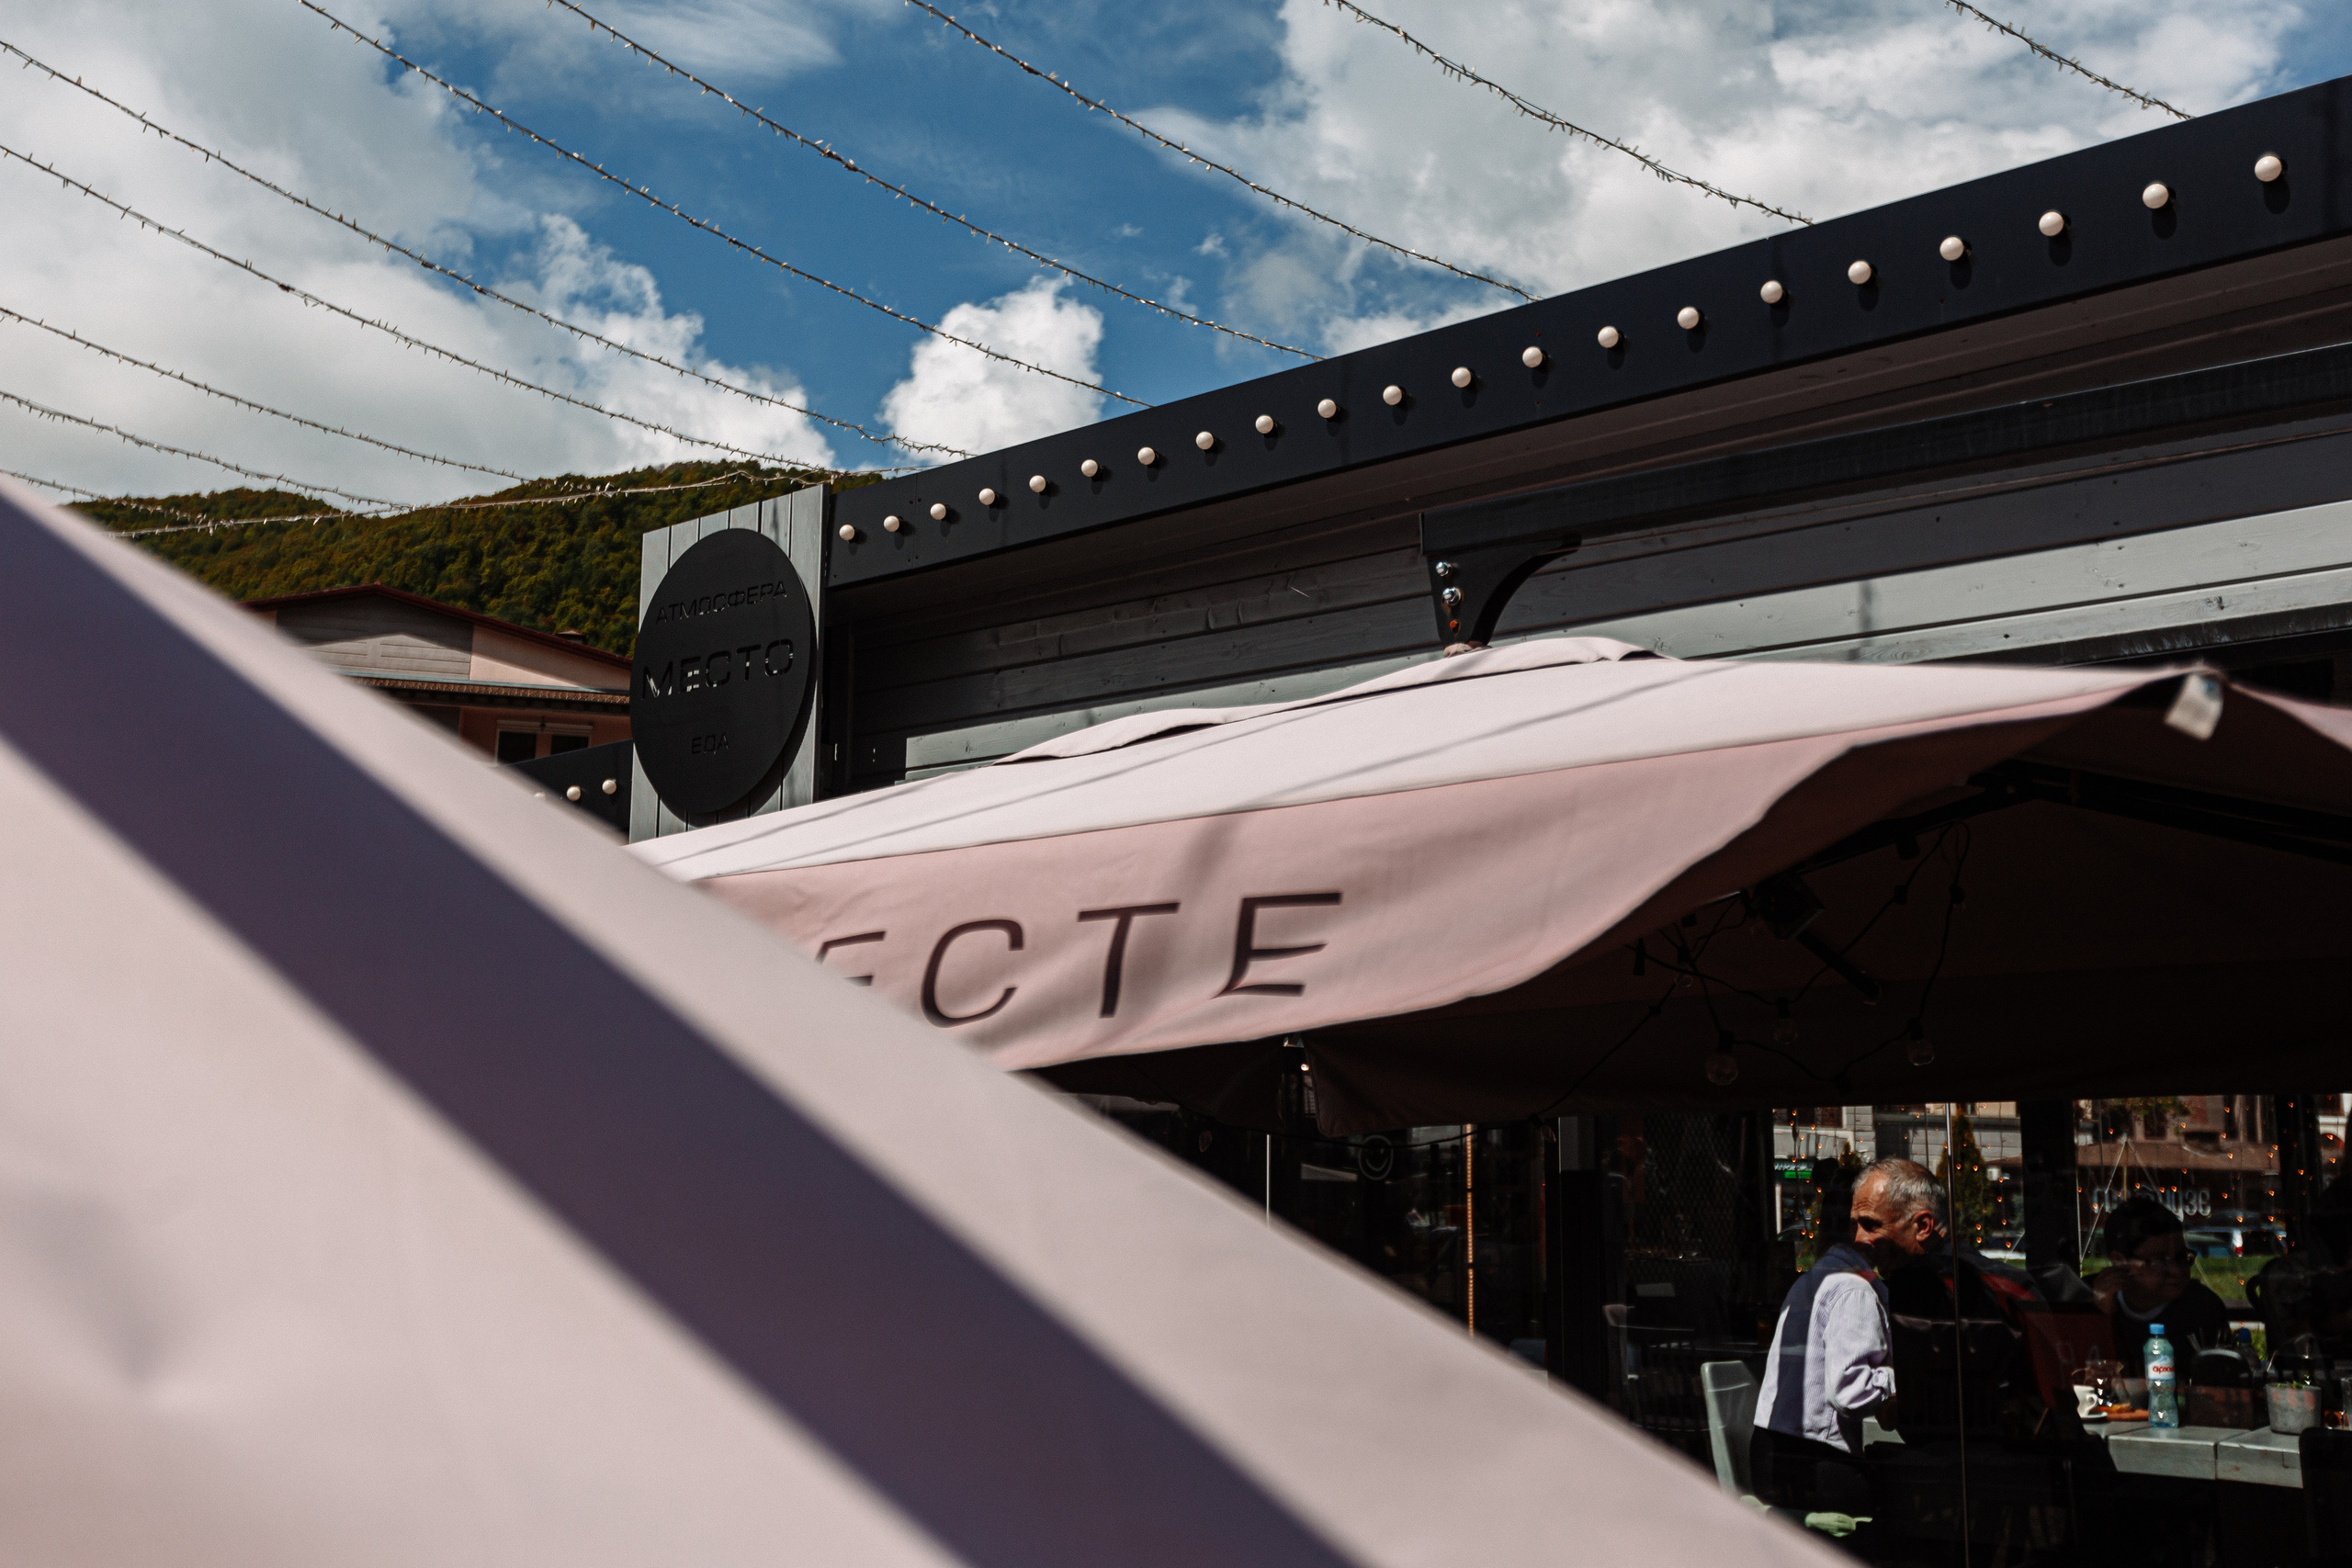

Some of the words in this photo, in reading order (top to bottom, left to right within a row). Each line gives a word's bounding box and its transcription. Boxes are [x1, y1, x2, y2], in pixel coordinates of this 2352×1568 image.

[655, 581, 788, 626] АТМОСФЕРА
[642, 638, 795, 700] МЕСТО
[691, 733, 730, 756] ЕДА
